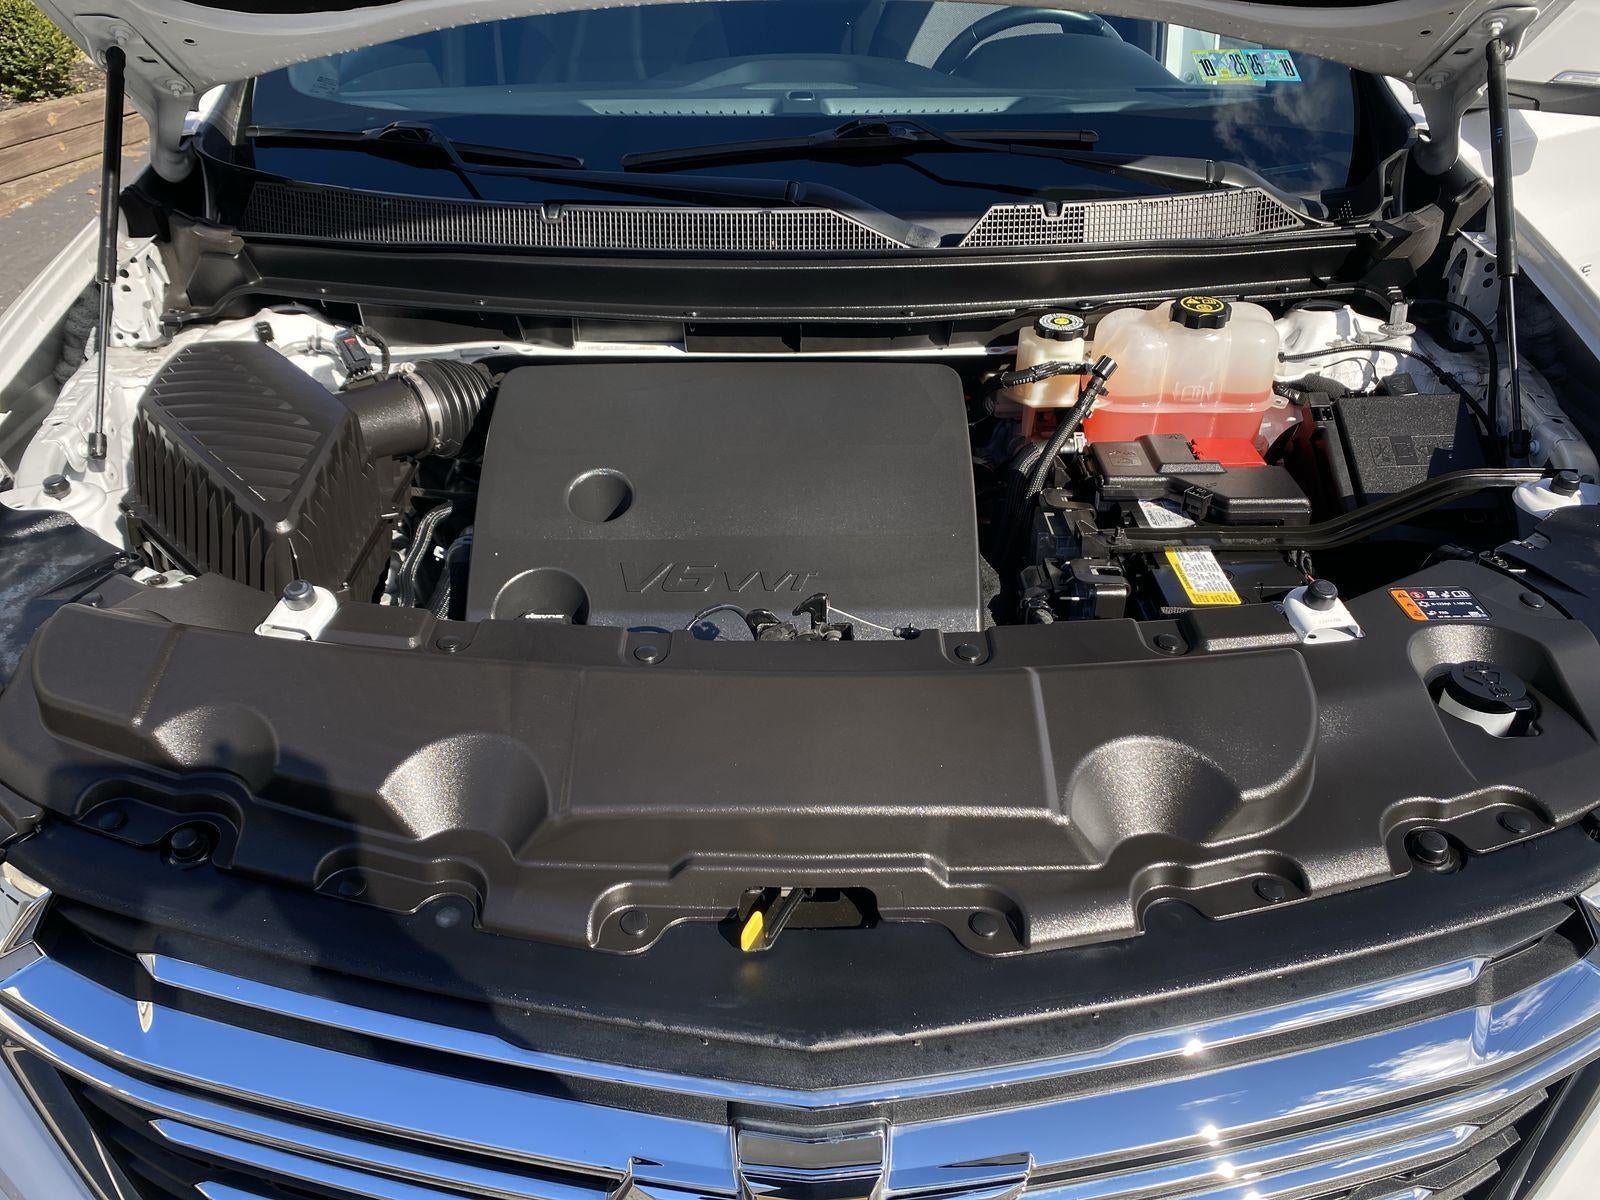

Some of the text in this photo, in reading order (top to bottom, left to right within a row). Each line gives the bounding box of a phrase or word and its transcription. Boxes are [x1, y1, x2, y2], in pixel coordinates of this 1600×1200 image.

[1199, 59, 1216, 77] 10
[1246, 54, 1296, 77] 26 10
[619, 561, 718, 593] V6
